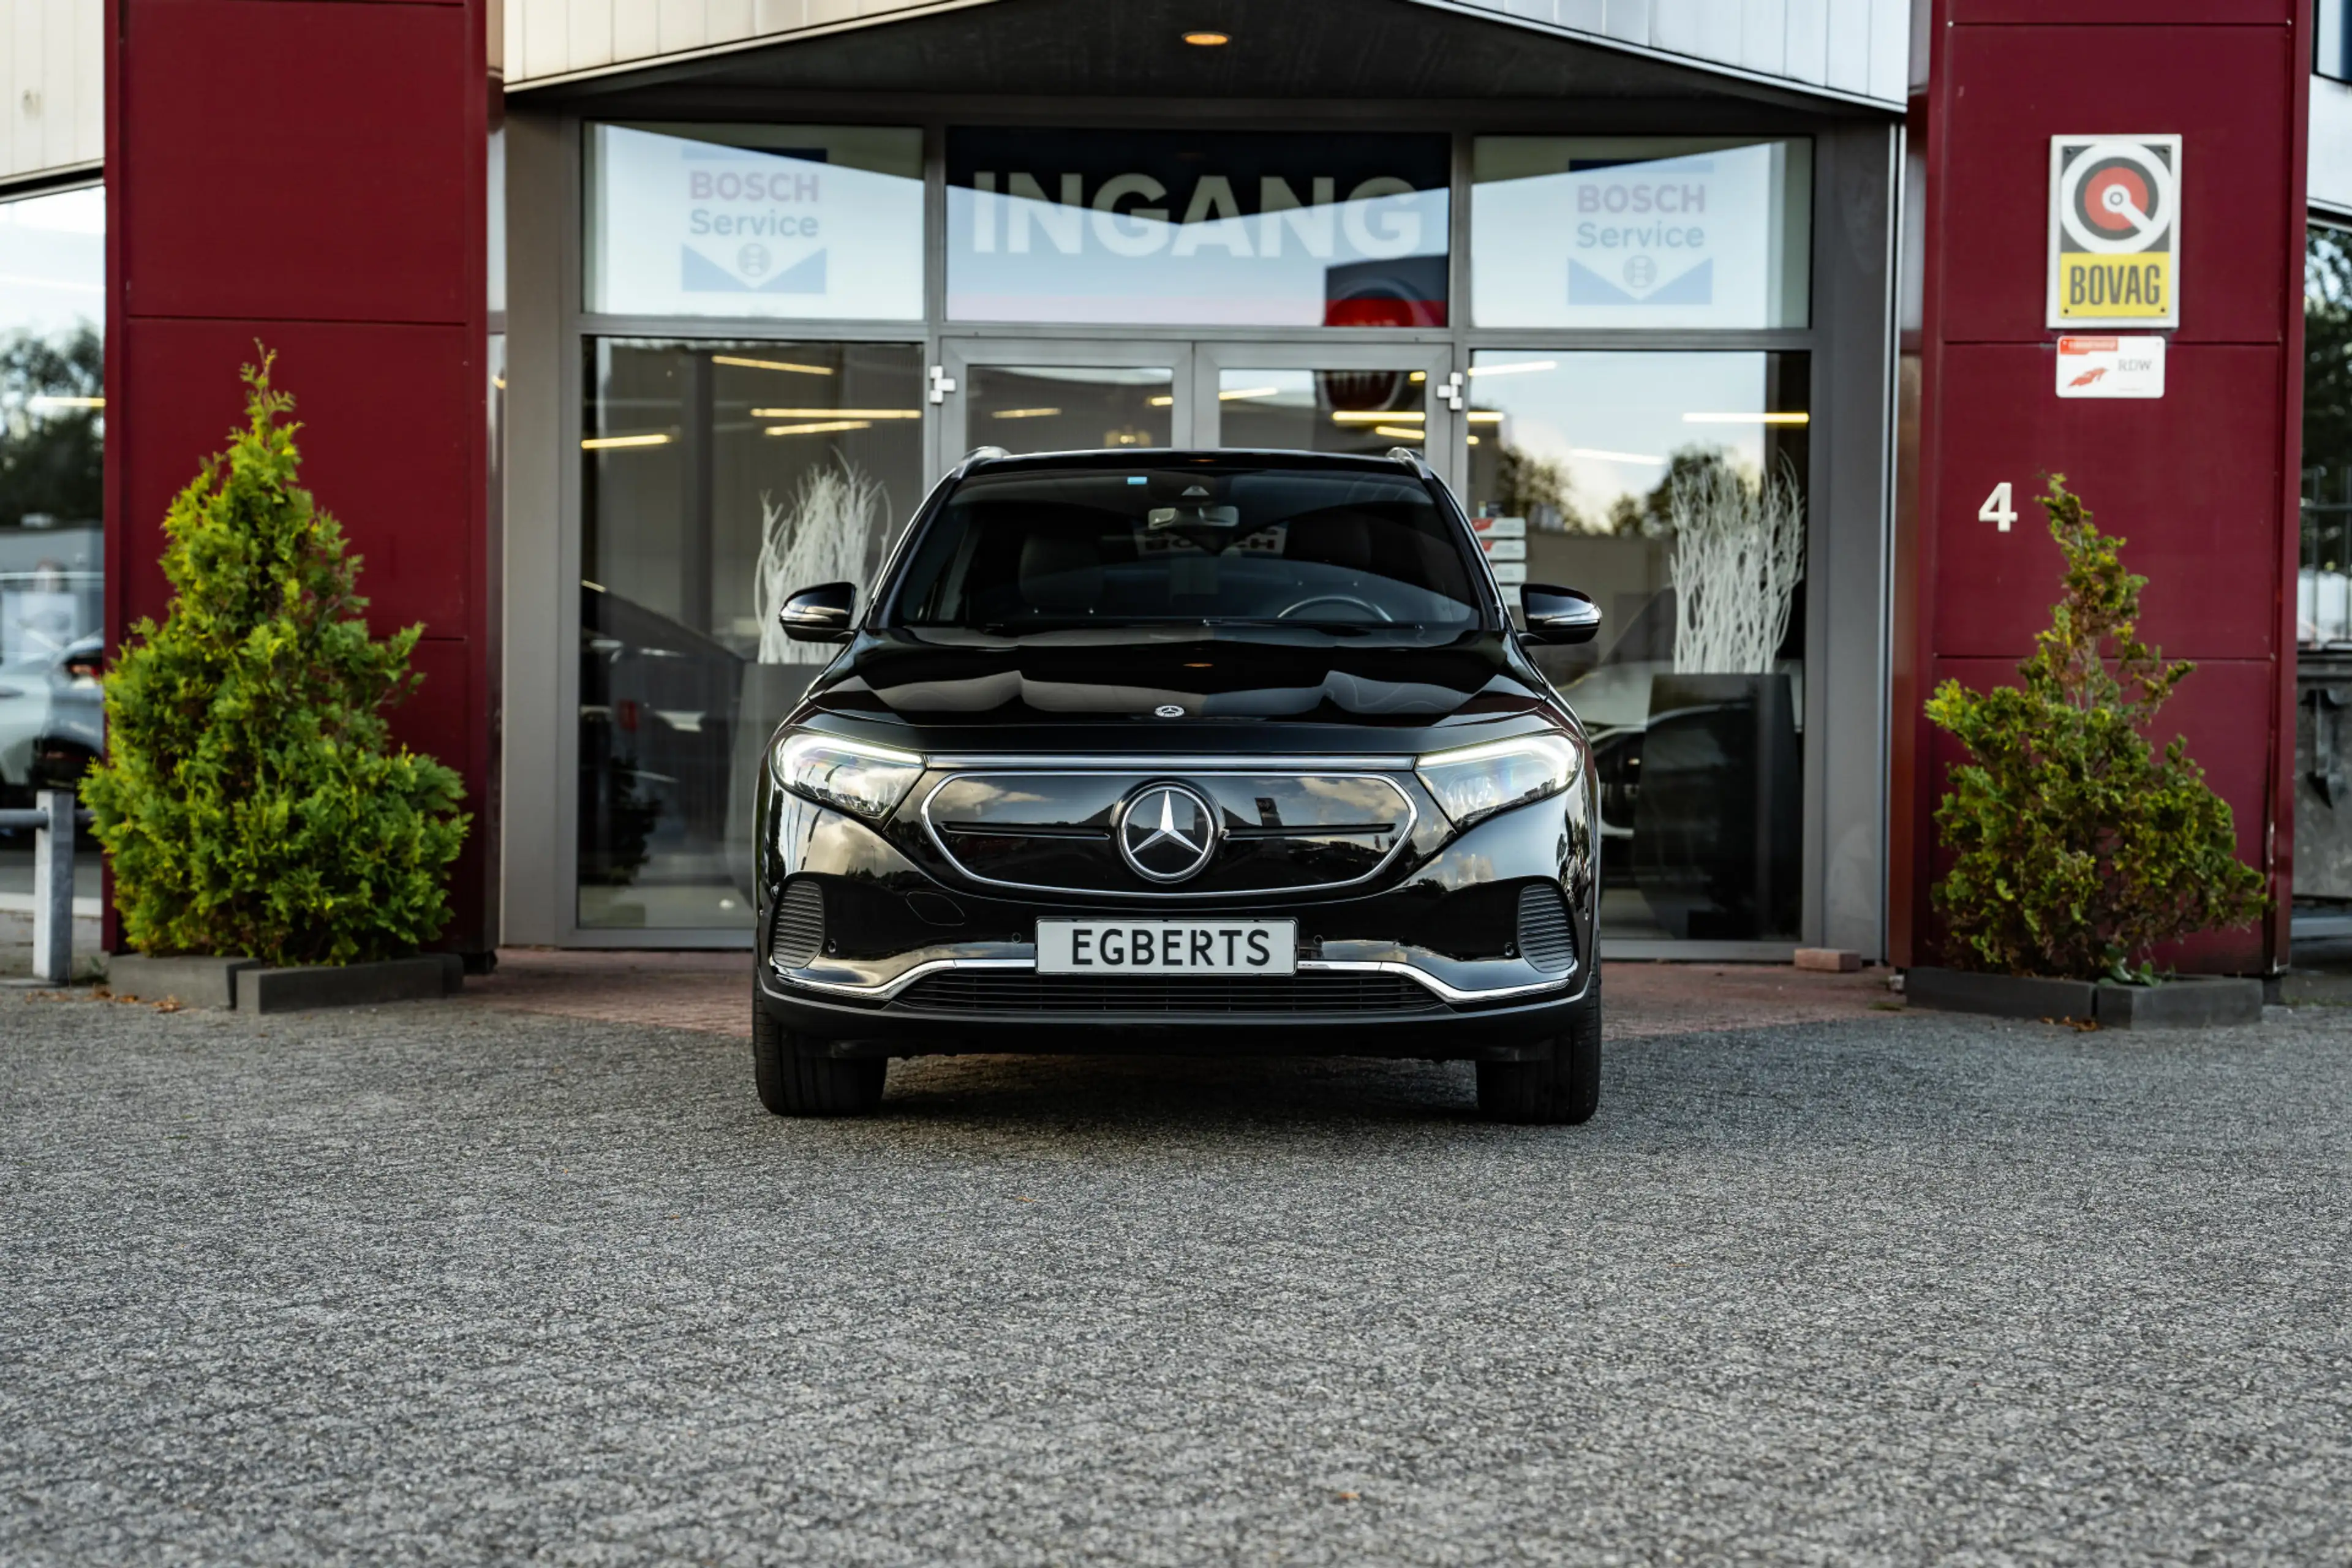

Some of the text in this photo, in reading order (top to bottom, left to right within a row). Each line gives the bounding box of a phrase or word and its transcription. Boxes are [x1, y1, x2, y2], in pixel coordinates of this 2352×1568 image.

[690, 170, 820, 203] BOSCH
[1577, 184, 1705, 214] BOSCH
[690, 208, 820, 238] Service
[973, 172, 1422, 259] INGANG
[1576, 220, 1705, 249] Service
[2070, 263, 2160, 306] BOVAG
[2118, 358, 2152, 372] RDW
[1978, 481, 2018, 532] 4
[1072, 928, 1271, 967] EGBERTS
